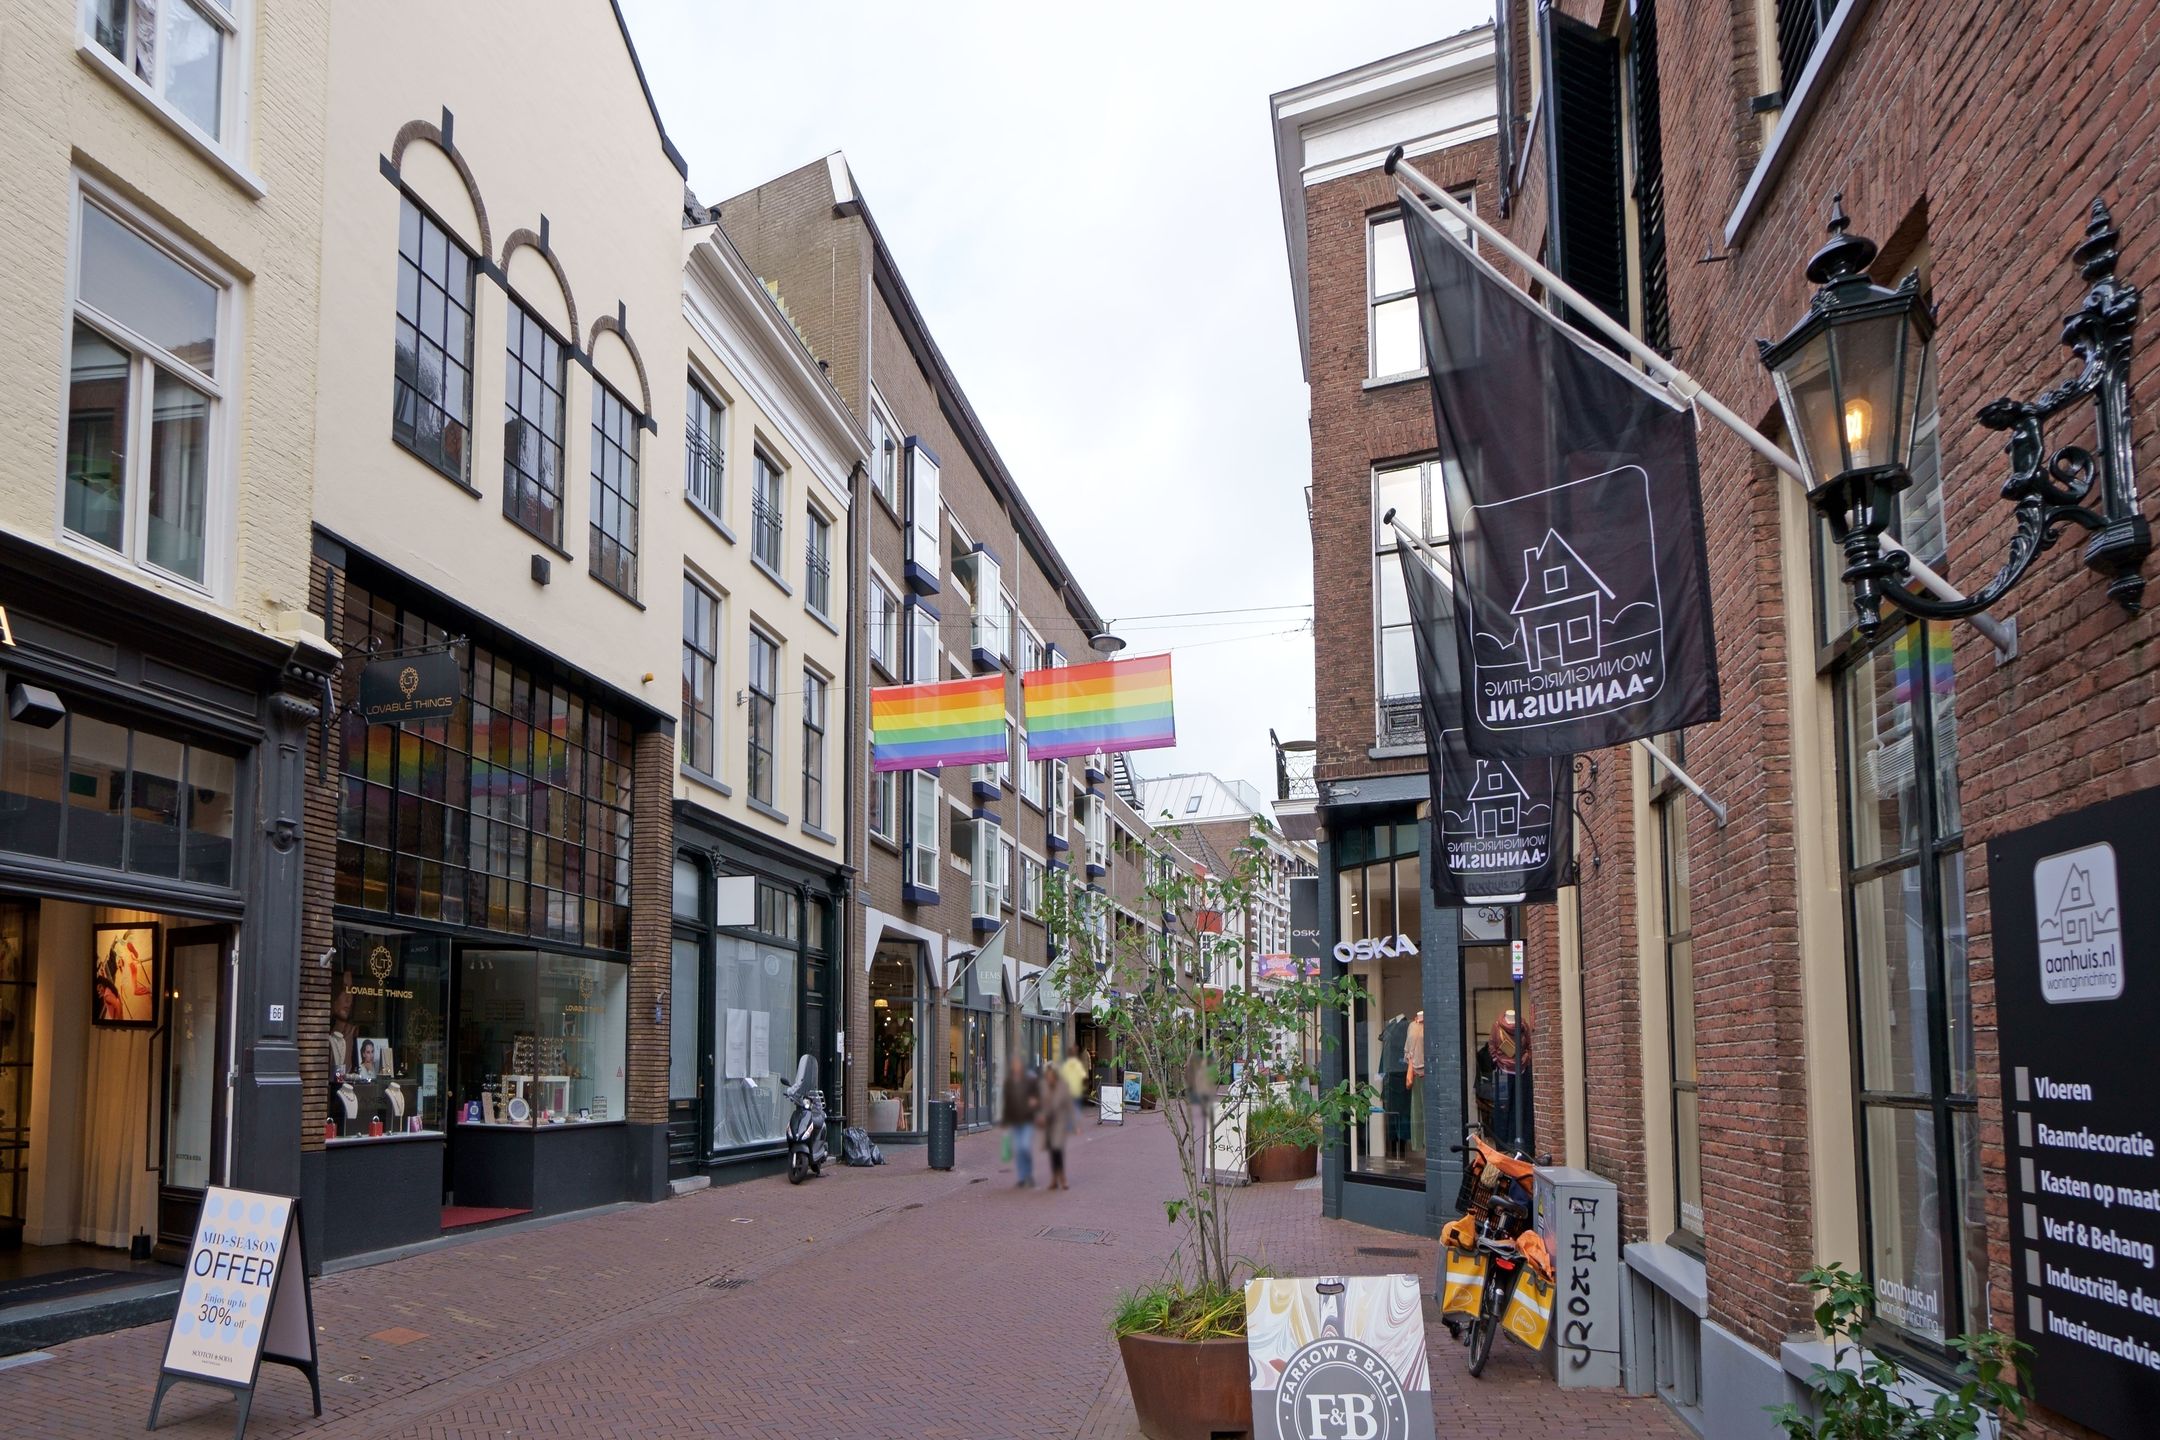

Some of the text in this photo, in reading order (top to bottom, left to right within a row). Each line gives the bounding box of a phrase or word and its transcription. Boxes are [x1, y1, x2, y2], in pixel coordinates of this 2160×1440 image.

[366, 697, 453, 715] LOVABLE THINGS
[1333, 934, 1419, 963] OSKA
[2046, 943, 2116, 974] aanhuis.nl
[345, 986, 413, 999] LOVABLE THINGS
[272, 1007, 282, 1020] 66
[2035, 1077, 2092, 1101] Vloeren
[2038, 1123, 2154, 1157] Raamdecoratie
[2040, 1170, 2160, 1212] Kasten op maat
[202, 1231, 276, 1254] MID-SEASON
[2043, 1216, 2154, 1268] Verf & Behang
[194, 1248, 275, 1288] OFFER
[204, 1292, 247, 1309] Enjoy up to
[1880, 1278, 1938, 1315] aanhuis.nl
[2047, 1263, 2160, 1318] Industriële deu
[198, 1303, 246, 1329] 30% off
[2049, 1310, 2160, 1371] Interieuradvie
[1281, 1345, 1398, 1407] FARROW & BALL
